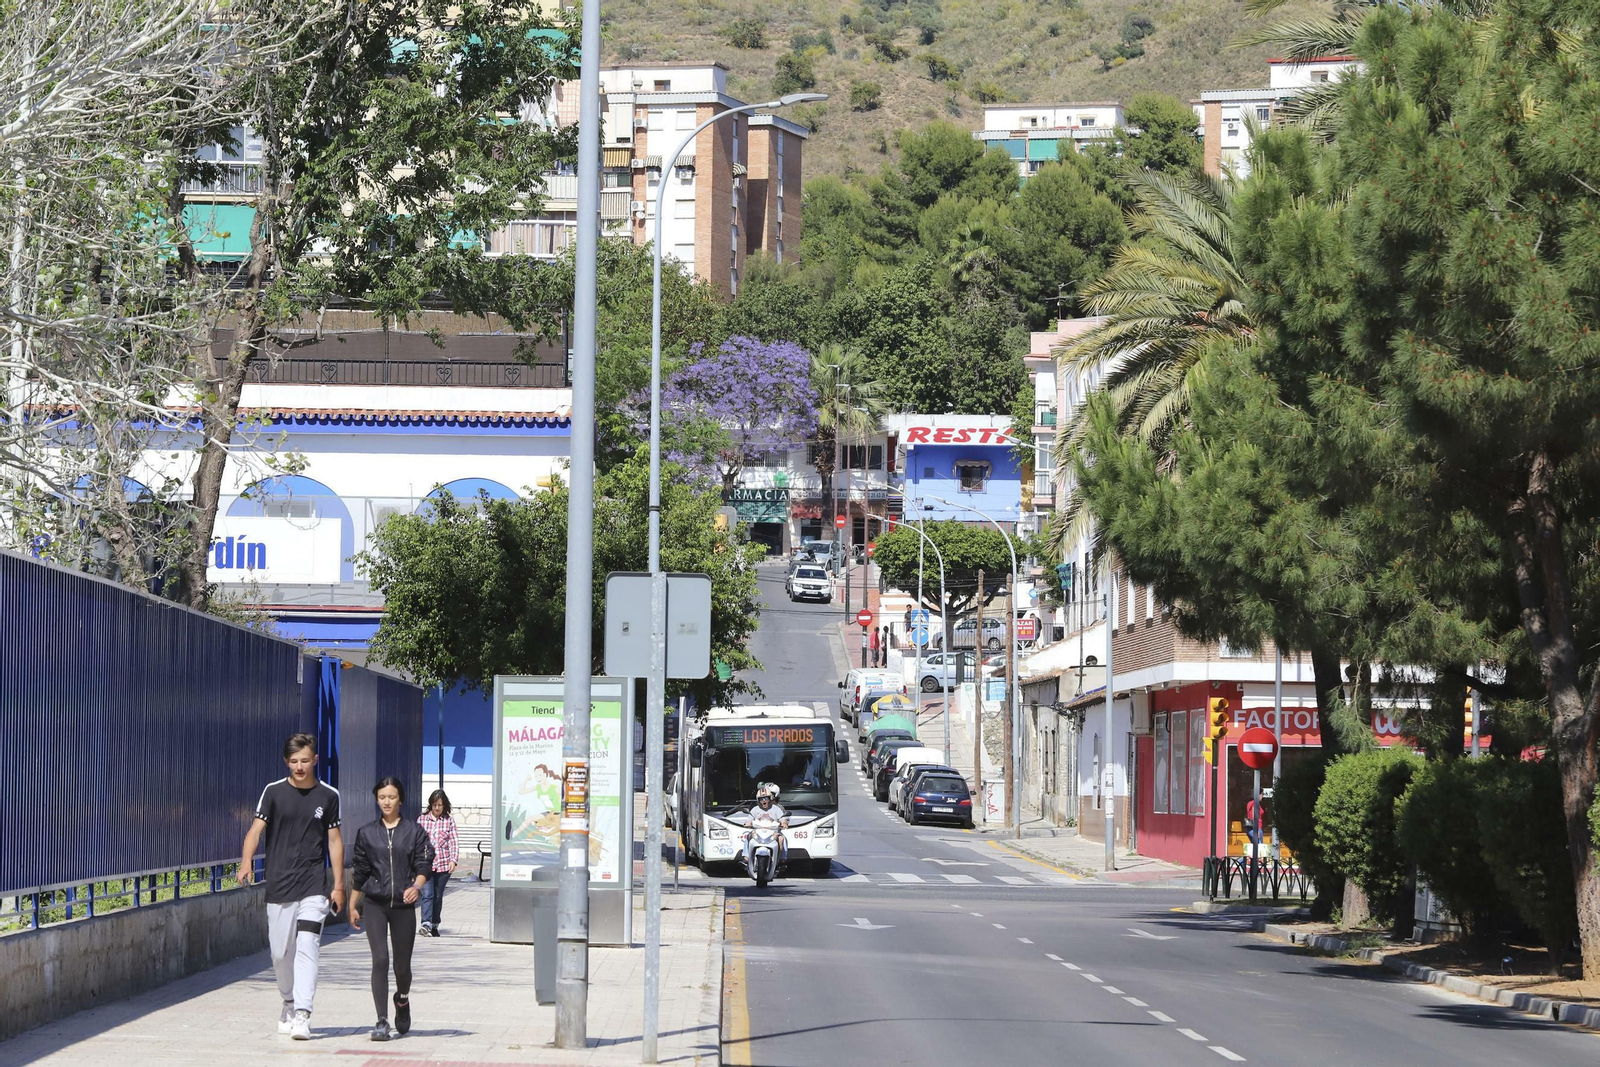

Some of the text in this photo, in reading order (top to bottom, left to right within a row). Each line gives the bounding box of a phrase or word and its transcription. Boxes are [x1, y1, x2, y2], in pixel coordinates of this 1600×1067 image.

[729, 489, 787, 500] RMACIA
[509, 726, 564, 743] MÁLAGA
[590, 724, 603, 737] G
[744, 729, 767, 743] LOS
[769, 728, 814, 743] PRADOS
[590, 737, 611, 750] TY
[793, 831, 808, 839] 663
